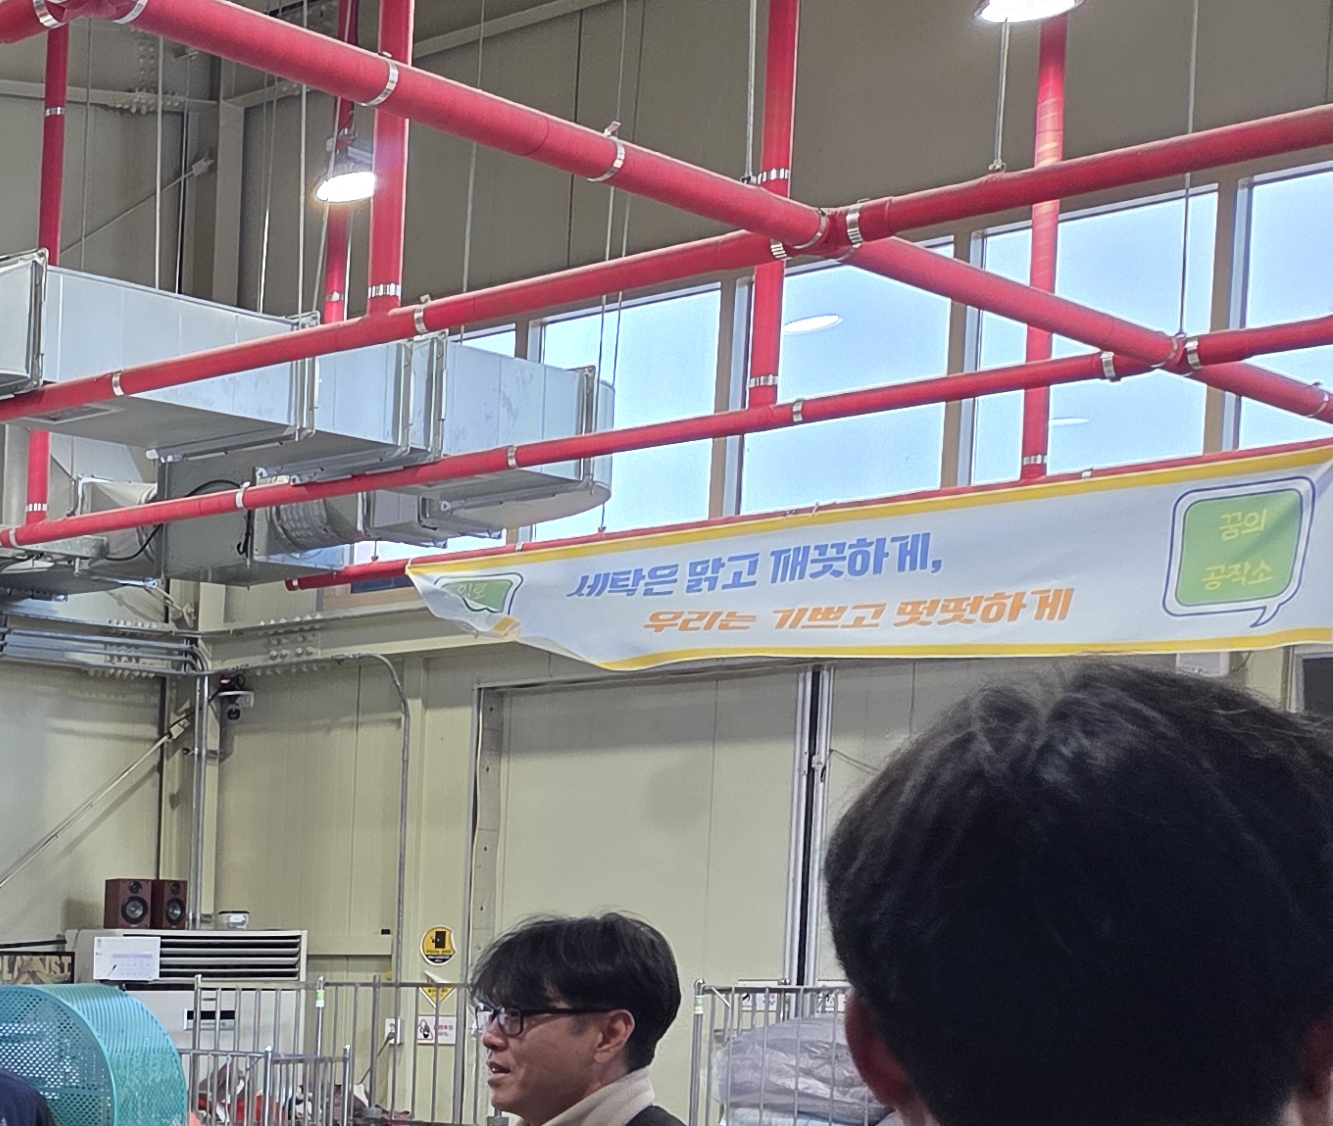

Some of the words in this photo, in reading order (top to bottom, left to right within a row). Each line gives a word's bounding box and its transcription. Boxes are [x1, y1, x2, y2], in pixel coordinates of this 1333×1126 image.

[1219, 508, 1268, 541] 꿈의
[566, 563, 679, 598] 세탁은
[686, 552, 760, 594] 맑고
[770, 531, 943, 584] 깨끗하게,
[1201, 560, 1273, 590] 공작소
[643, 610, 757, 633] 우리는
[772, 602, 887, 630] 기쁘고
[893, 587, 1075, 627] 떳떳하게
